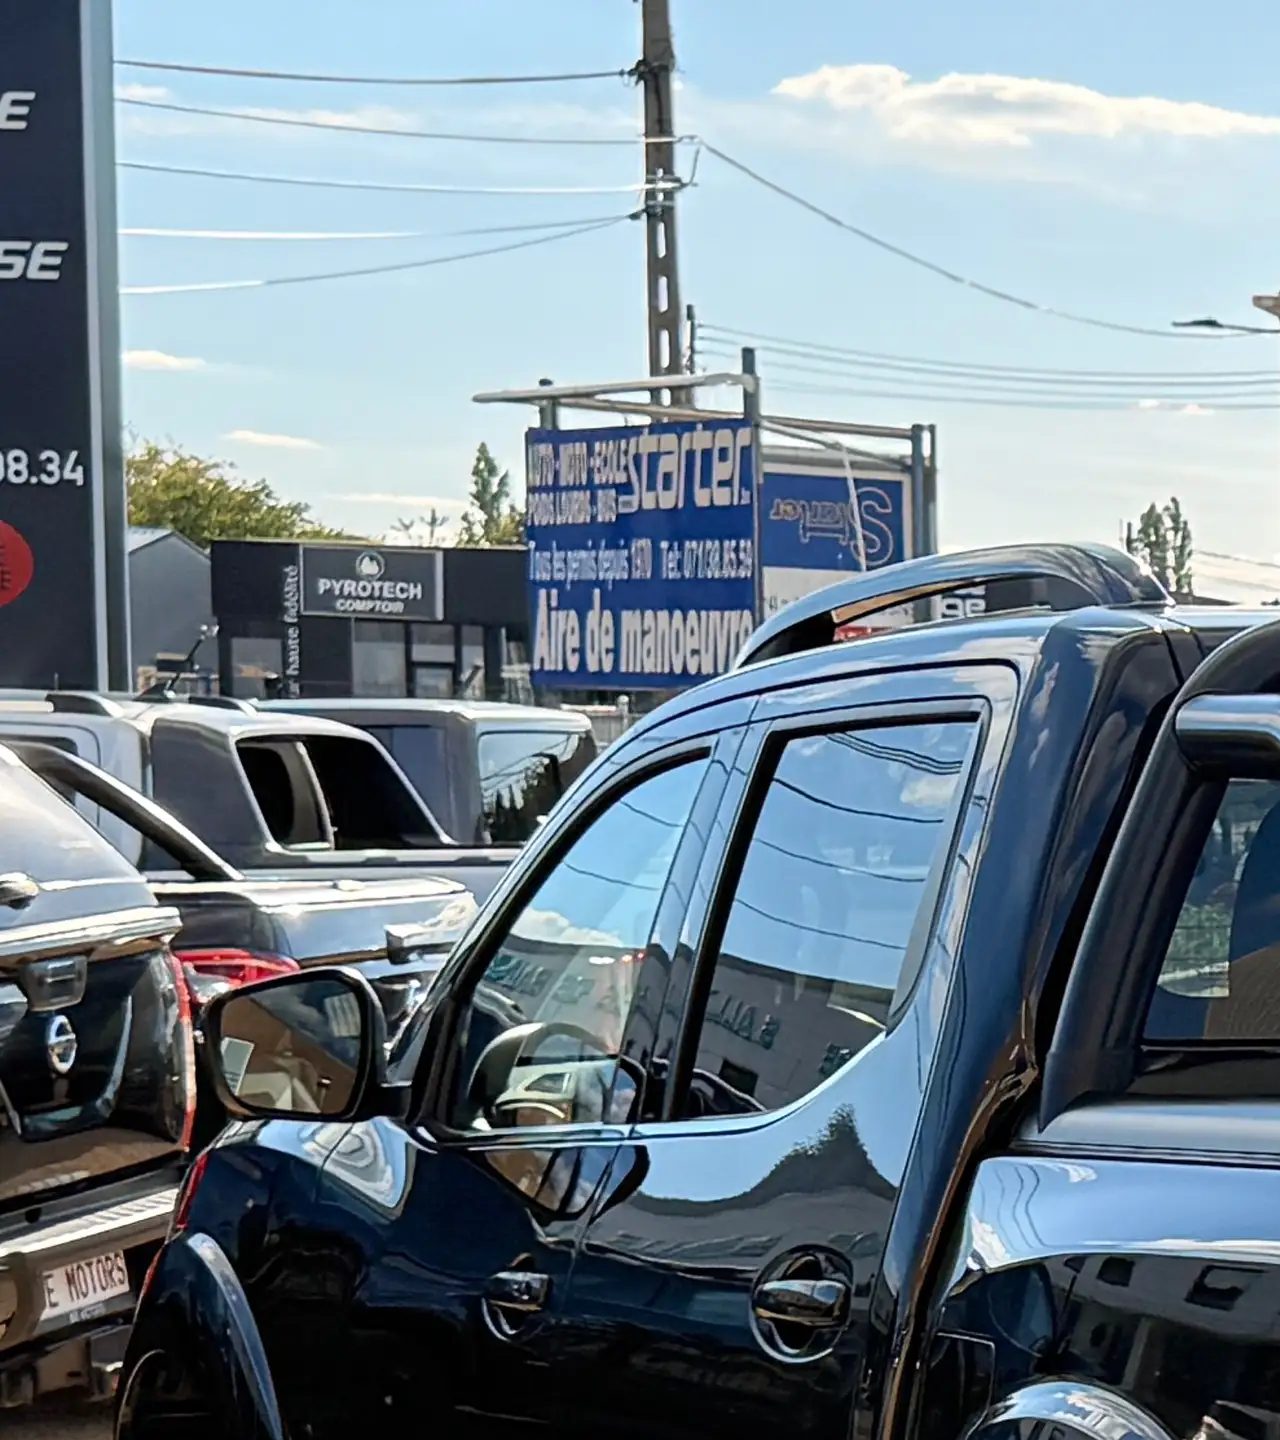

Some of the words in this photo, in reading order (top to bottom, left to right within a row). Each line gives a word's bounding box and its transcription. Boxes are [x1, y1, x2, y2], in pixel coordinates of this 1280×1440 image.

[0, 448, 84, 487] 8.34
[317, 578, 423, 600] PYROTECH
[335, 599, 405, 614] COMPTOIR
[533, 588, 580, 672] Aire
[586, 588, 615, 673] de
[65, 1251, 125, 1302] MOTORS
